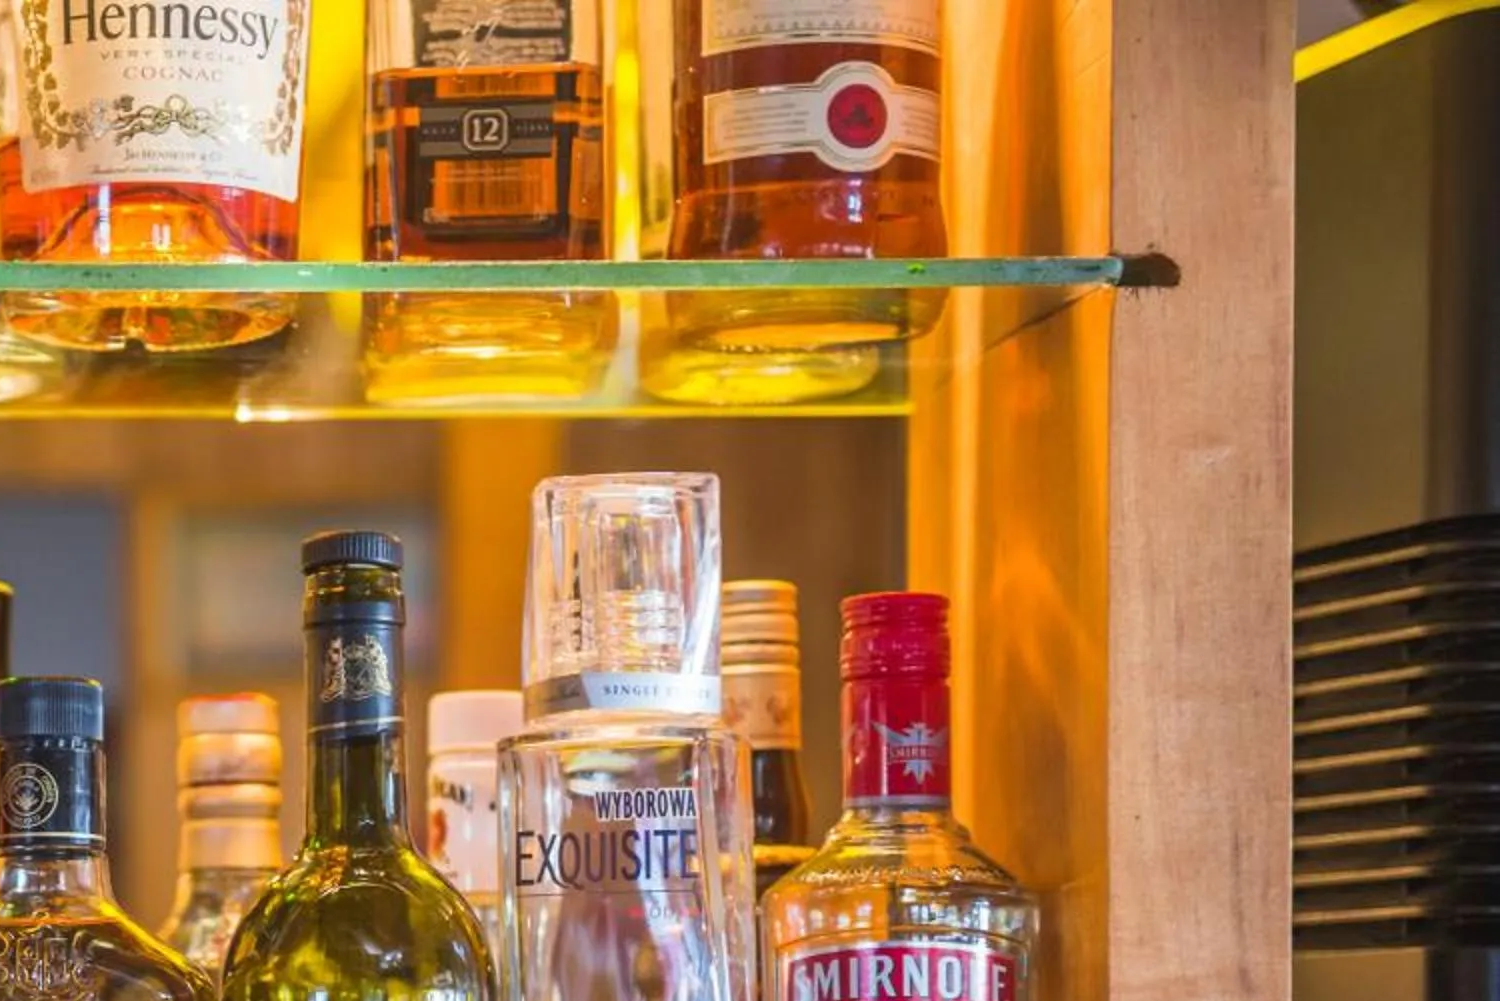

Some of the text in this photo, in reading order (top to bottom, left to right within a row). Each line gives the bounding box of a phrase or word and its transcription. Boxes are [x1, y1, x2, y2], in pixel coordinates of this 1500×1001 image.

[63, 0, 278, 60] Hennessy
[100, 49, 151, 62] VERY
[122, 65, 224, 83] COGNAC
[472, 117, 500, 143] 12
[596, 789, 697, 819] WYBOROWA
[515, 828, 700, 890] EXQUISITE
